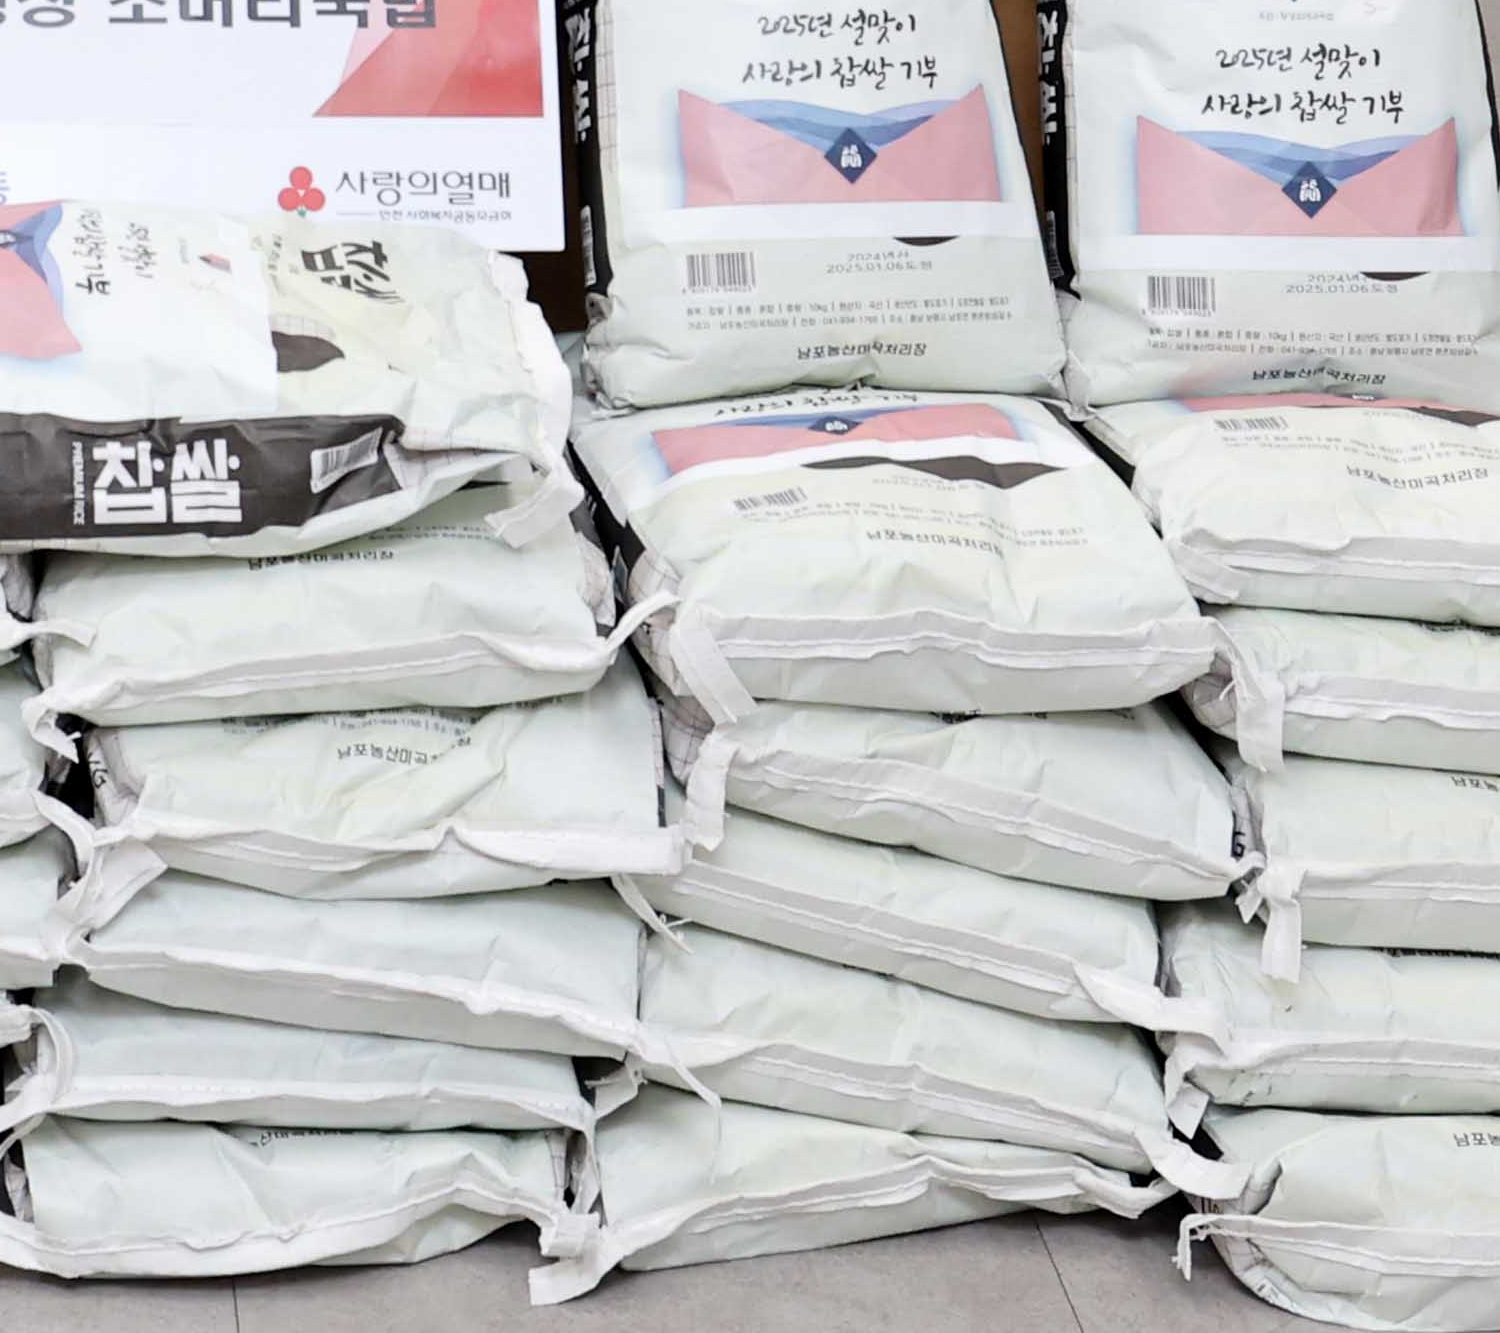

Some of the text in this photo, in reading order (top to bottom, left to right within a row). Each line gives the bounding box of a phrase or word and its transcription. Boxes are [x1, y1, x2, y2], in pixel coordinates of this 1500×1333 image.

[758, 8, 916, 46] 2025년 설맞이
[742, 55, 938, 91] 사랑의 찹쌀 기부
[1215, 42, 1381, 81] 2025년 설맞이
[1202, 90, 1404, 125] 사랑의 찹쌀 기부
[336, 170, 511, 206] 사랑의열매
[94, 438, 243, 524] 찹쌀
